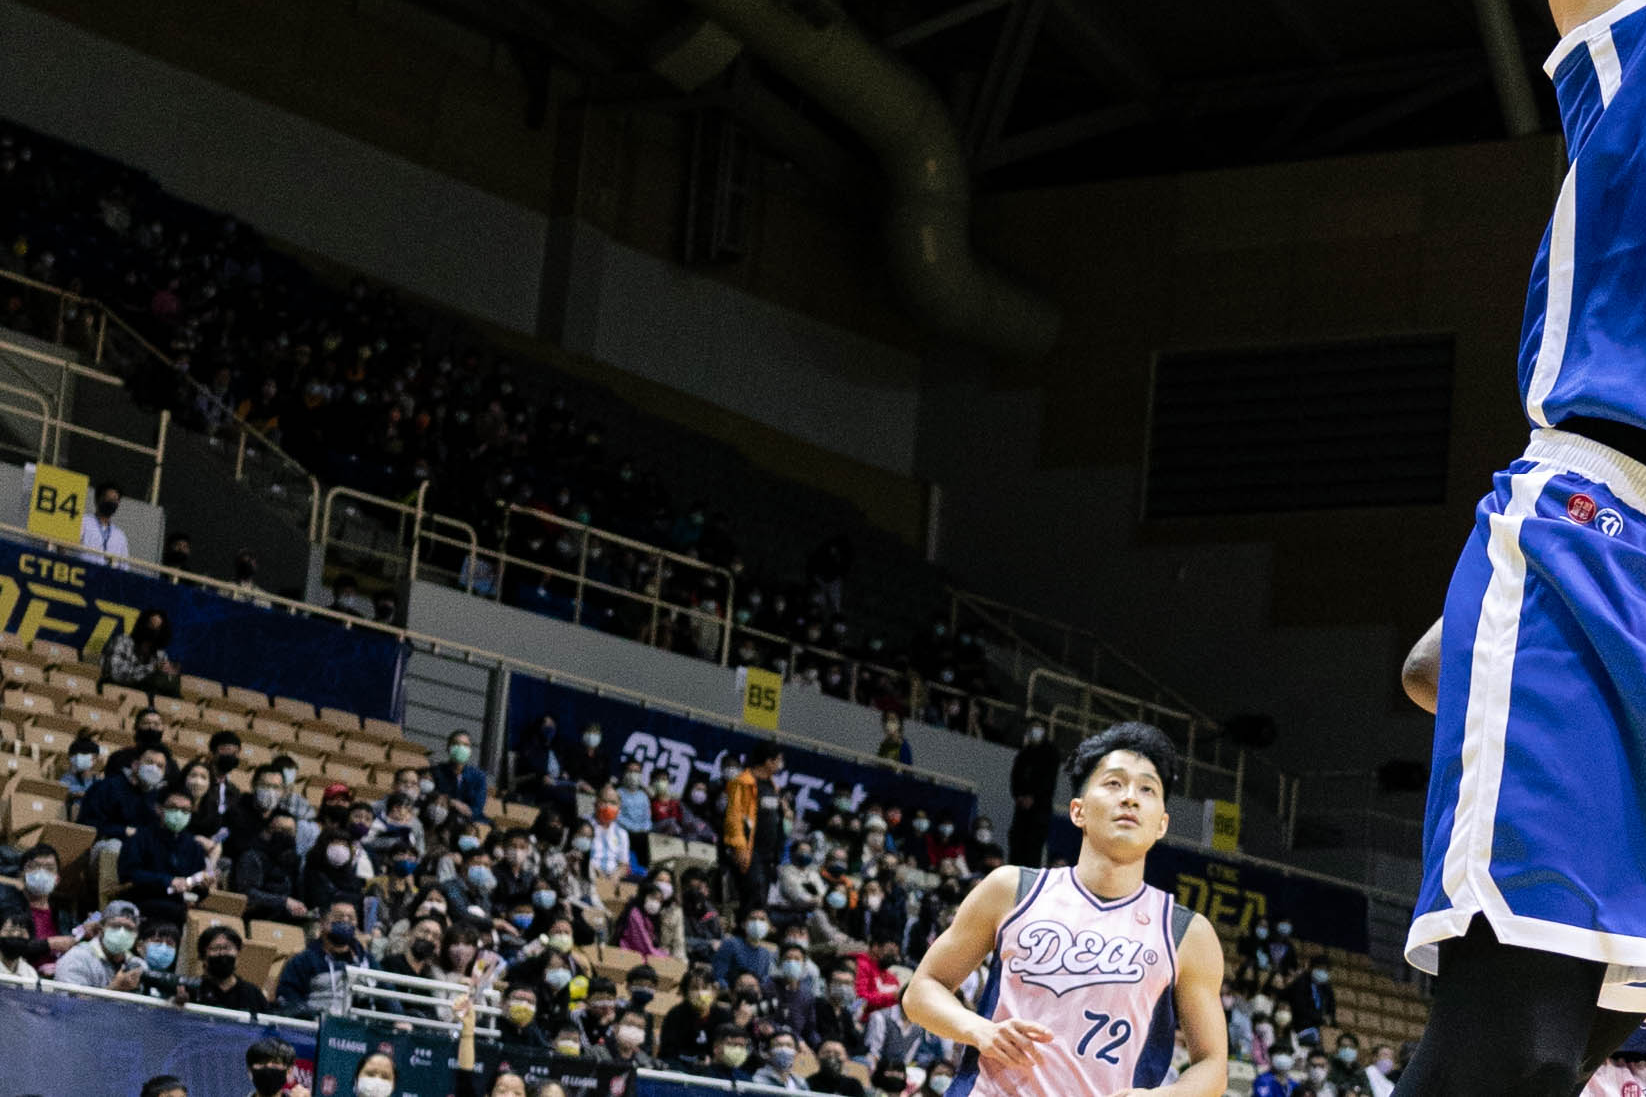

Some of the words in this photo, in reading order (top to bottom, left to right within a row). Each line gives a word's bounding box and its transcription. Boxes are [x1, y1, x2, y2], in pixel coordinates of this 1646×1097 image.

[37, 484, 79, 521] B4
[18, 552, 87, 588] CTBC
[1075, 1010, 1132, 1065] 72
